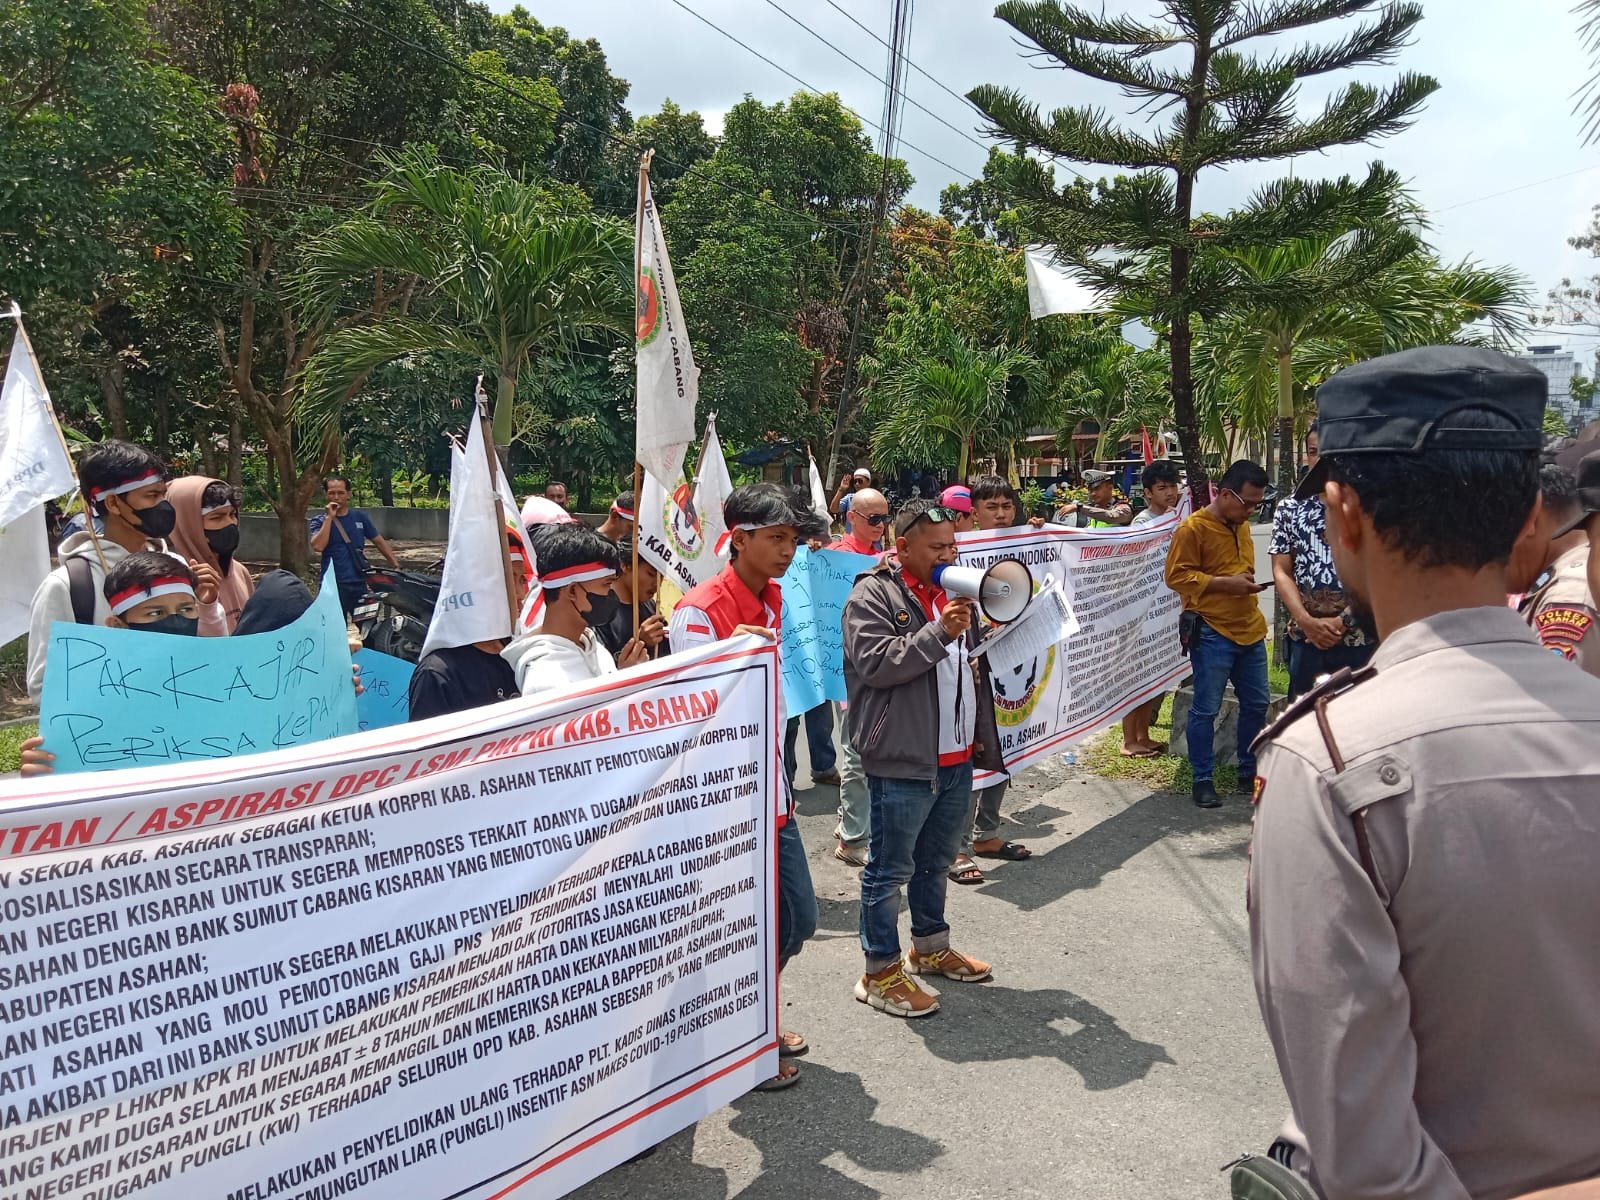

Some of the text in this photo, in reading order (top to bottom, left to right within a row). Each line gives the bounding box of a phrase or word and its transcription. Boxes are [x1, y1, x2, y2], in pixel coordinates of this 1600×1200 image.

[669, 336, 686, 399] CABANG
[645, 534, 673, 566] KAB.
[674, 562, 698, 590] ASAH
[1538, 610, 1589, 624] POLRES
[1543, 616, 1583, 626] ASAHAN
[50, 713, 257, 767] PERIKSA
[57, 637, 162, 702] PAK
[1016, 720, 1047, 746] ASAHAN
[18, 858, 93, 886] SEKDA
[101, 849, 147, 870] KAB.
[154, 832, 235, 860] ASAHAN
[240, 814, 315, 844] SEBAGAI
[321, 802, 374, 828] KETUA
[378, 789, 437, 816] KORPRI
[440, 783, 475, 804] KAB.
[480, 770, 536, 796] ASAHAN
[538, 759, 591, 783] TERKAIT
[595, 741, 679, 772] PEMOTONGAN
[699, 726, 737, 746] KORPRI
[740, 723, 758, 739] DAN
[138, 689, 718, 835] ASPIRASI DPC LSM PMPRI KAB. ASAHAN
[37, 760, 758, 948] NEGERI KISARAN UNTUK SEGERA MEMPROSES TERKAIT ADANYA DUGAAN KONSPIRASI JAHAT YANG
[42, 817, 757, 1047] NEGERI KISARAN UNTUK SEGERA MELAKUKAN PENYELIDIKAN TERHADAP KEPALA CABANG BANK SUMUT
[83, 780, 757, 969] DENGAN BANK SUMUT CABANG KISARAN YANG MEMOTONG UANG KORPRI DAN UANG ZAKAT TANPA
[26, 879, 702, 1122] AKIBAT DARI INI BANK SUMUT CABANG KISARAN MENJADI OJK (OTORITAS JASA KEUANGAN);
[50, 907, 724, 1171] KAMI DUGA SELAMA MENJABAT ± 8 TAHUN MEMILIKI HARTA DAN KEKAYAAN MILYARAN RUPIAH;
[52, 836, 756, 1079] ASAHAN YANG MOU PEMOTONGAN GAJI PNS YANG TERINDIKASI MENYALAHI UNDANG-UNDANG
[78, 876, 757, 1133] PP LHKPN KPK RI UNTUK MELAKUKAN PEMERIKSAAN HARTA DAN KEUANGAN KEPALA BAPPEDA KAB.
[180, 932, 757, 1173] PUNGLI (KW) TERHADAP SELURUH OPD KAB. ASAHAN SEBESAR 10% YANG MEMPUNYAI
[342, 970, 758, 1159] PENYELIDIKAN ULANG TERHADAP PLT. KADIS DINAS KESEHATAN (HARI
[401, 990, 758, 1167] LIAR (PUNGLI) INSENTIF ASN NAKES COVID-19 PUSKESMAS DESA
